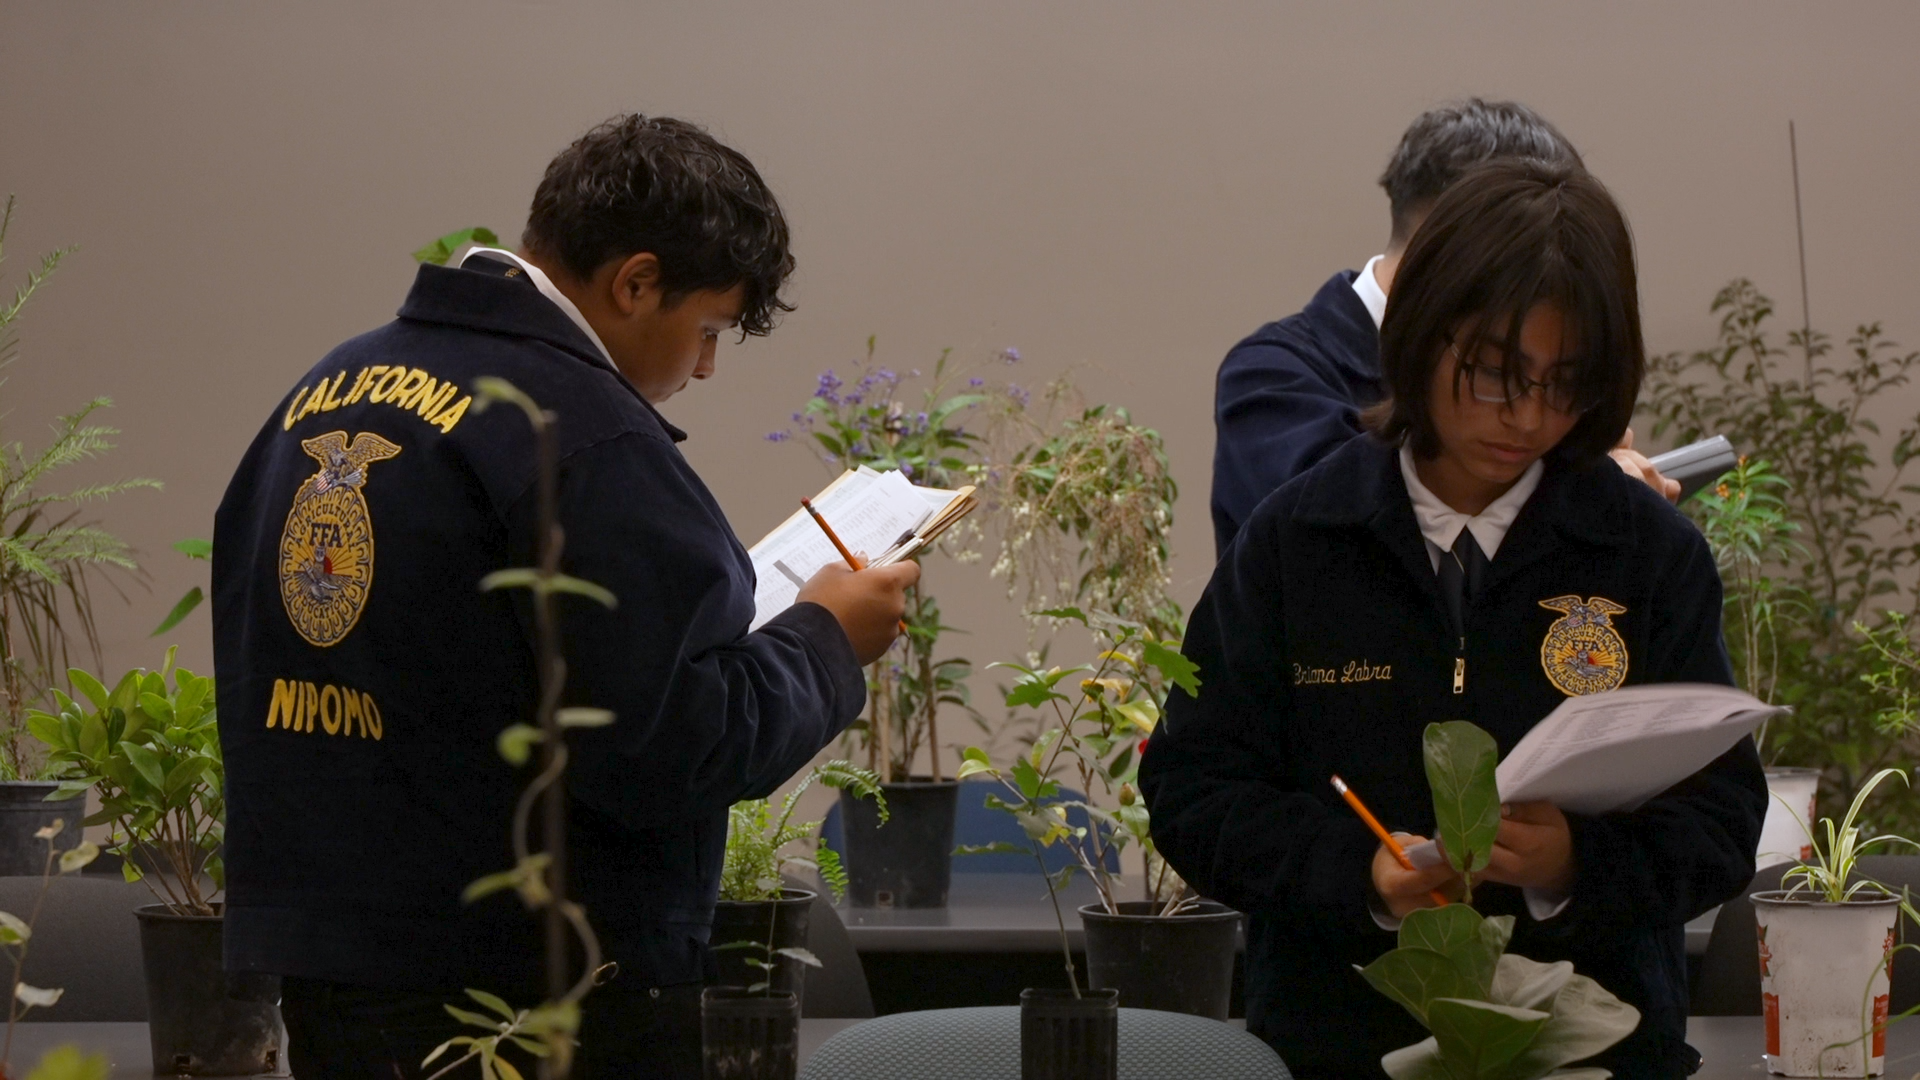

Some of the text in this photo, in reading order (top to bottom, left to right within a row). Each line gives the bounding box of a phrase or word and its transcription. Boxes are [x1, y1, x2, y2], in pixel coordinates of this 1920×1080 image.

[283, 365, 472, 434] CALIFORNIA
[309, 522, 344, 548] FFA
[1572, 639, 1602, 652] FFA
[1341, 658, 1392, 683] Labra
[266, 678, 383, 741] NIPOMO
